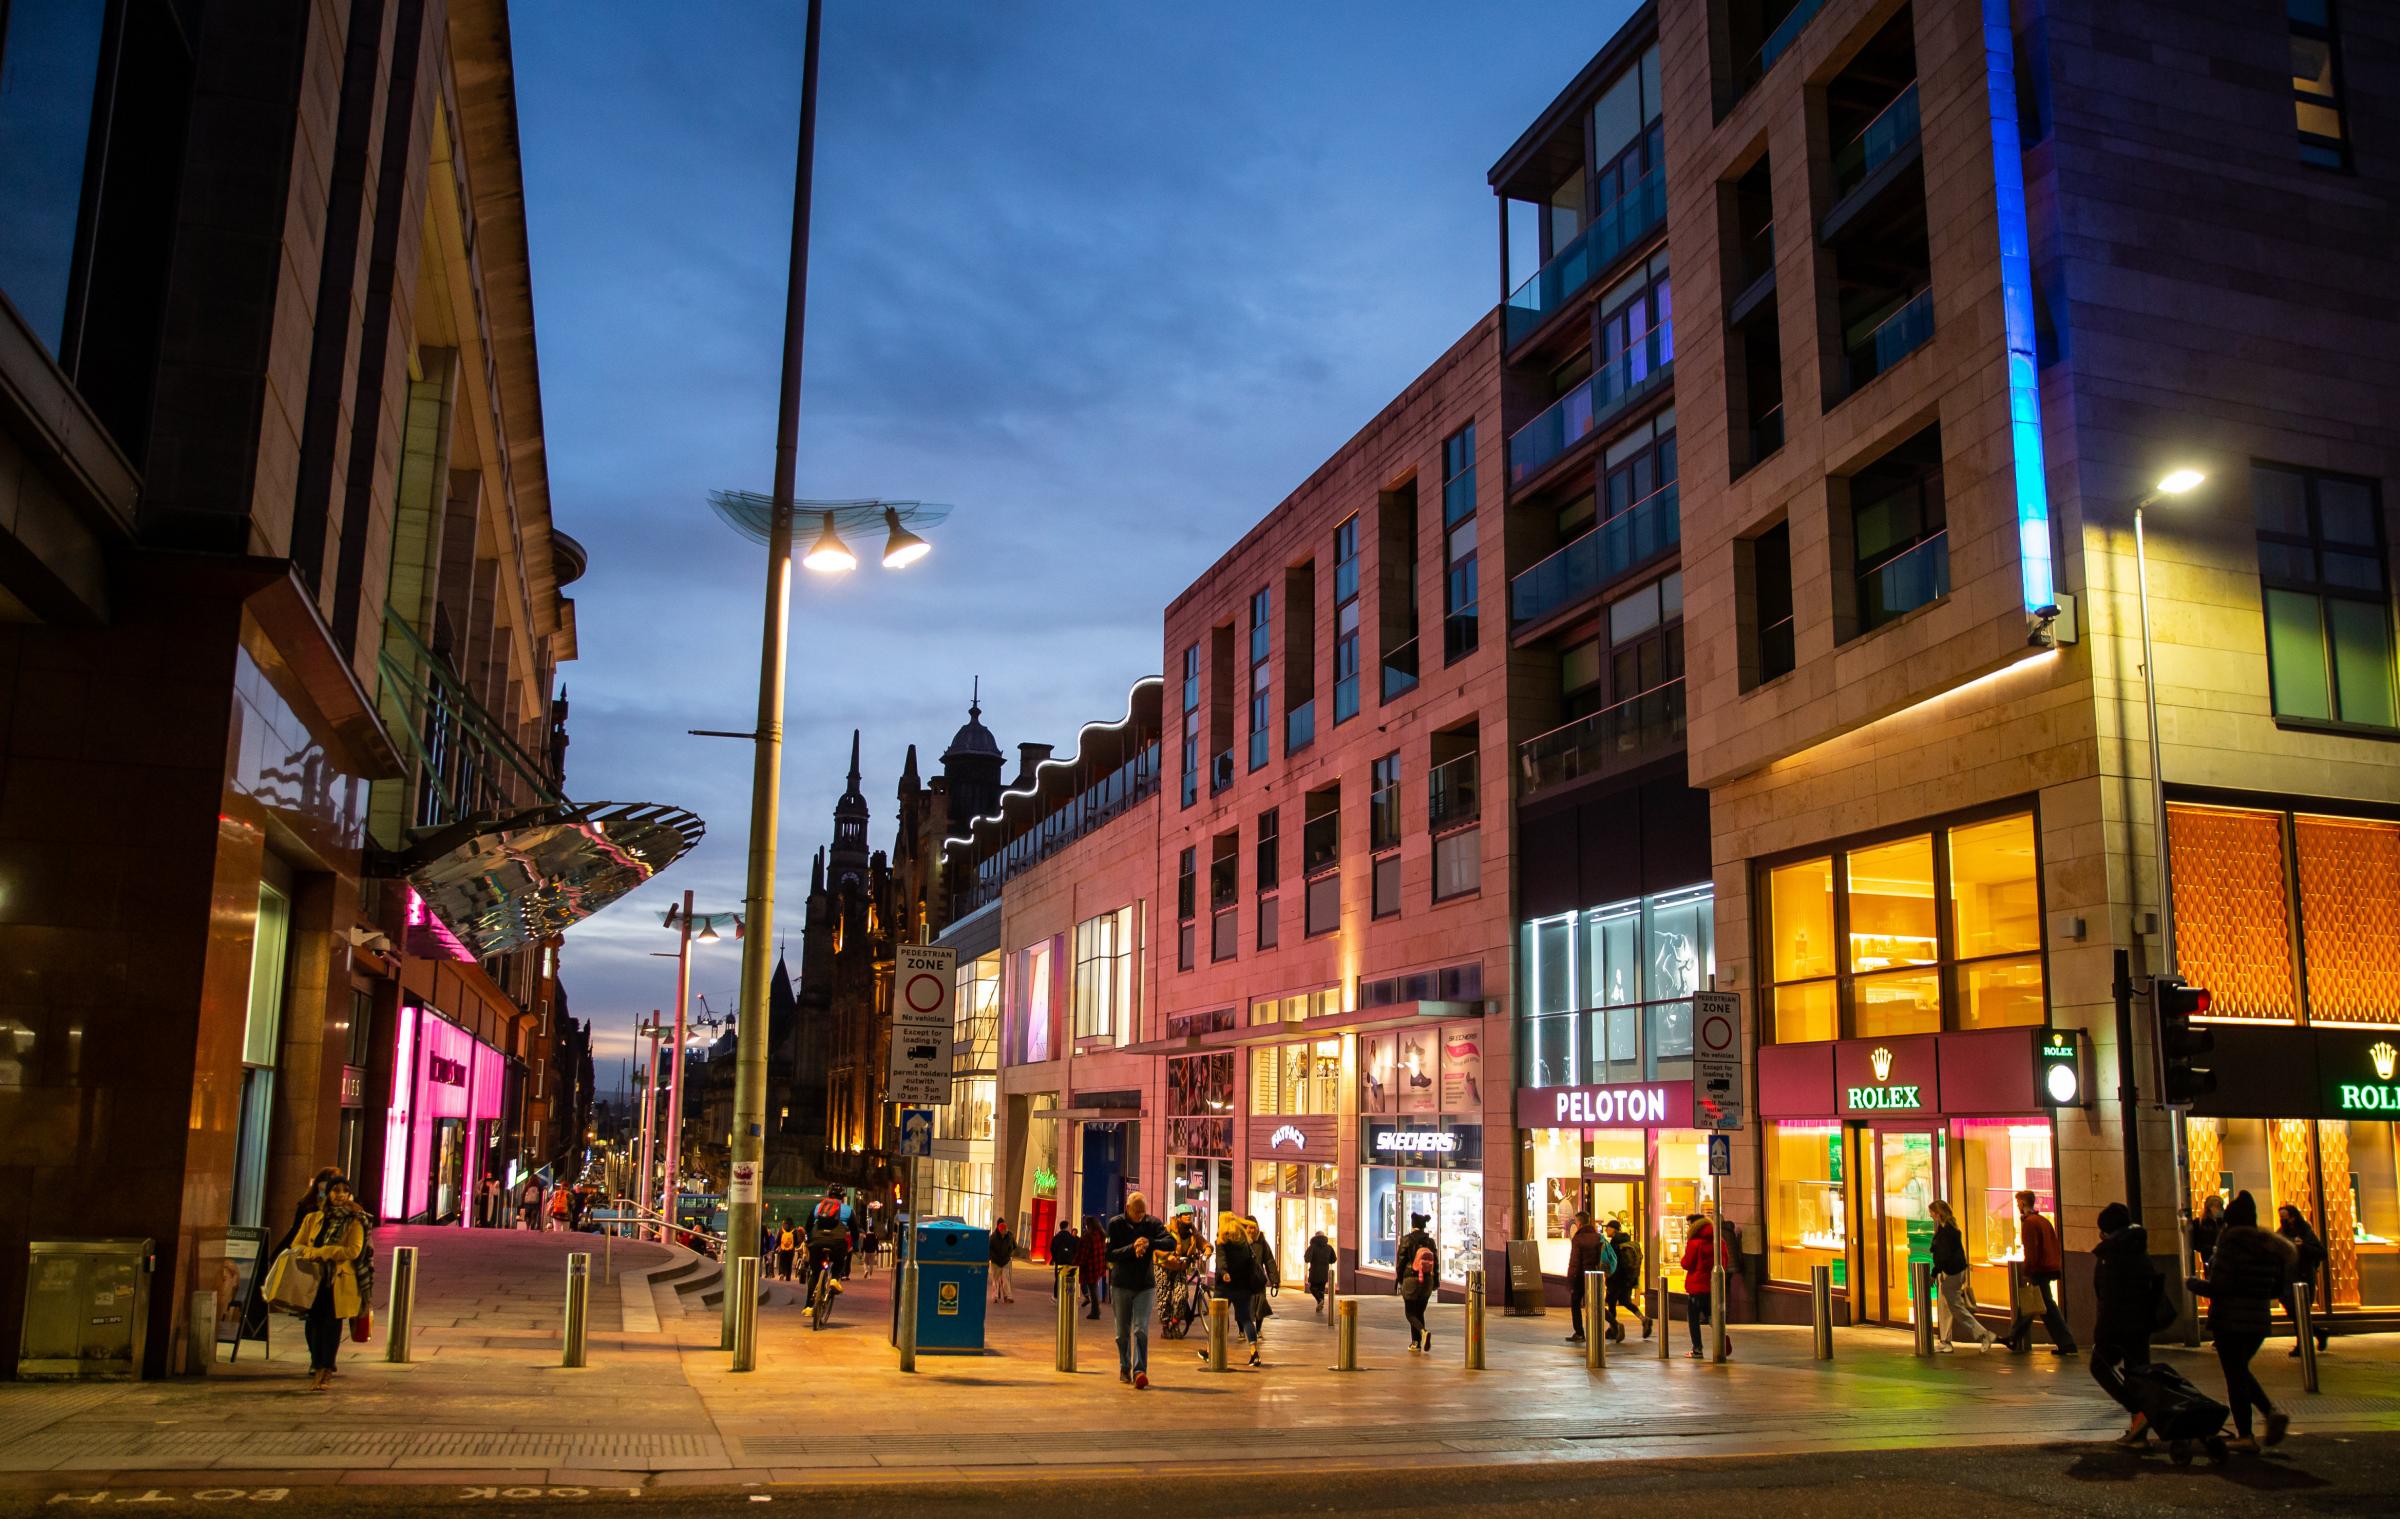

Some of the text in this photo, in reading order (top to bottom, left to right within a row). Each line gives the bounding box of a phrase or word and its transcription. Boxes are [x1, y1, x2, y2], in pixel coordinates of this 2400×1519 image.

[901, 949, 952, 958] PEDESTRIAN
[907, 958, 944, 970] ZONE
[1697, 994, 1737, 1002] PEDESTRIAN
[1703, 1003, 1731, 1013] ZONE
[903, 1028, 929, 1036] Except
[903, 1036, 942, 1046] loading by
[2043, 1047, 2073, 1056] ROLEX
[920, 1070, 948, 1078] holders
[1848, 1086, 1920, 1109] ROLEX
[1556, 1089, 1665, 1122] PELOTON
[1376, 1132, 1454, 1151] SKECHERS
[1190, 1171, 1203, 1188] VANS
[46, 1487, 641, 1504] LOOK BOTH
